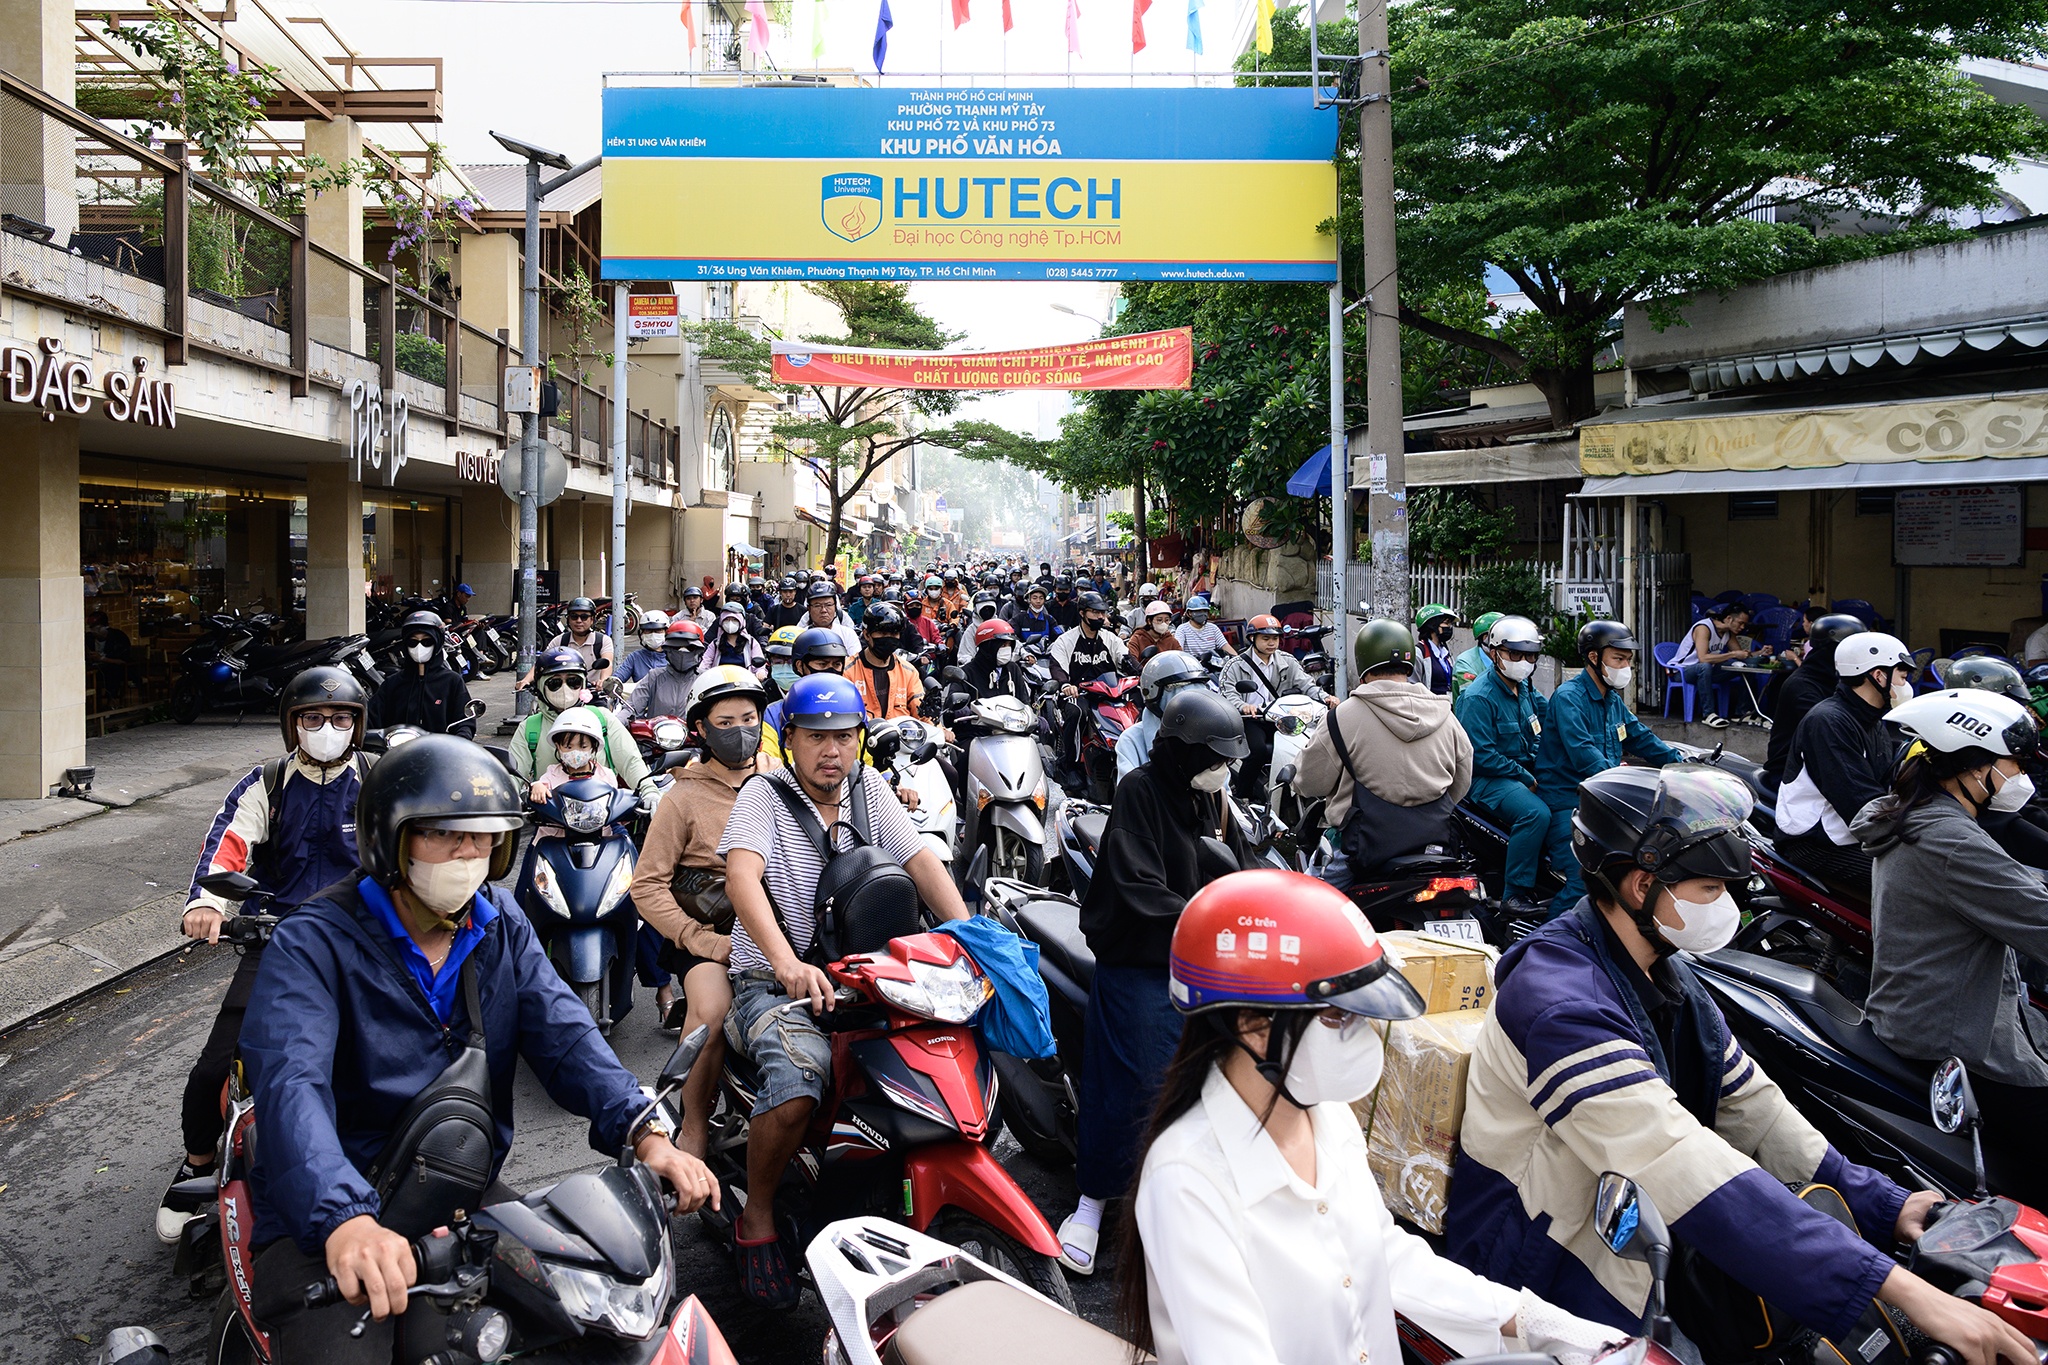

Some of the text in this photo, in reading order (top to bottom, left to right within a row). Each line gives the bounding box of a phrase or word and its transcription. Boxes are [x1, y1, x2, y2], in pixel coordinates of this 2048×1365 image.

[909, 89, 1033, 102] THÀNH PHỐ HỒ CHÍ MINH
[897, 102, 1046, 118] PHƯỜNG THẠNH MỸ TÂY
[887, 117, 1055, 132] KHU PHỐ 72 VÀ KHU PHỐ 73
[607, 137, 706, 147] HẺM 31 UNG VĂN KHIÊM
[880, 132, 1062, 155] KHU PHỐ VĂN HÓA
[833, 177, 871, 186] HUTECH
[833, 186, 870, 195] University
[893, 176, 1121, 220] HUTECH
[893, 229, 1121, 249] Đại học Công nghệ Tp.HCM
[697, 265, 1245, 280] 31/36 Ung Văn Khiêm, Phường Thạnh Mỹ Tây, TP. Hồ Chí Minh (028) 5445 7777 www.hutech.edu.vn
[1152, 336, 1177, 352] TẬT
[868, 354, 889, 368] TRỊ
[894, 356, 917, 368] KỊP
[1060, 354, 1070, 366] Y
[1095, 351, 1131, 366] NÂNG
[1135, 353, 1164, 366] CAO
[1, 337, 176, 429] ĐẶC SẢN
[913, 367, 1082, 387] CHẤT LƯỢNG CUỘC SỐNG
[1886, 409, 1969, 455] CÔ
[779, 629, 796, 641] be
[1945, 711, 1993, 738] POC
[473, 787, 494, 798] Royal
[1465, 816, 1510, 846] AIRBLAD
[1237, 915, 1277, 929] Có trên
[1433, 923, 1474, 940] 59-T2
[1247, 950, 1267, 960] Now
[927, 1035, 957, 1046] HONDA
[851, 1114, 891, 1150] HONDA
